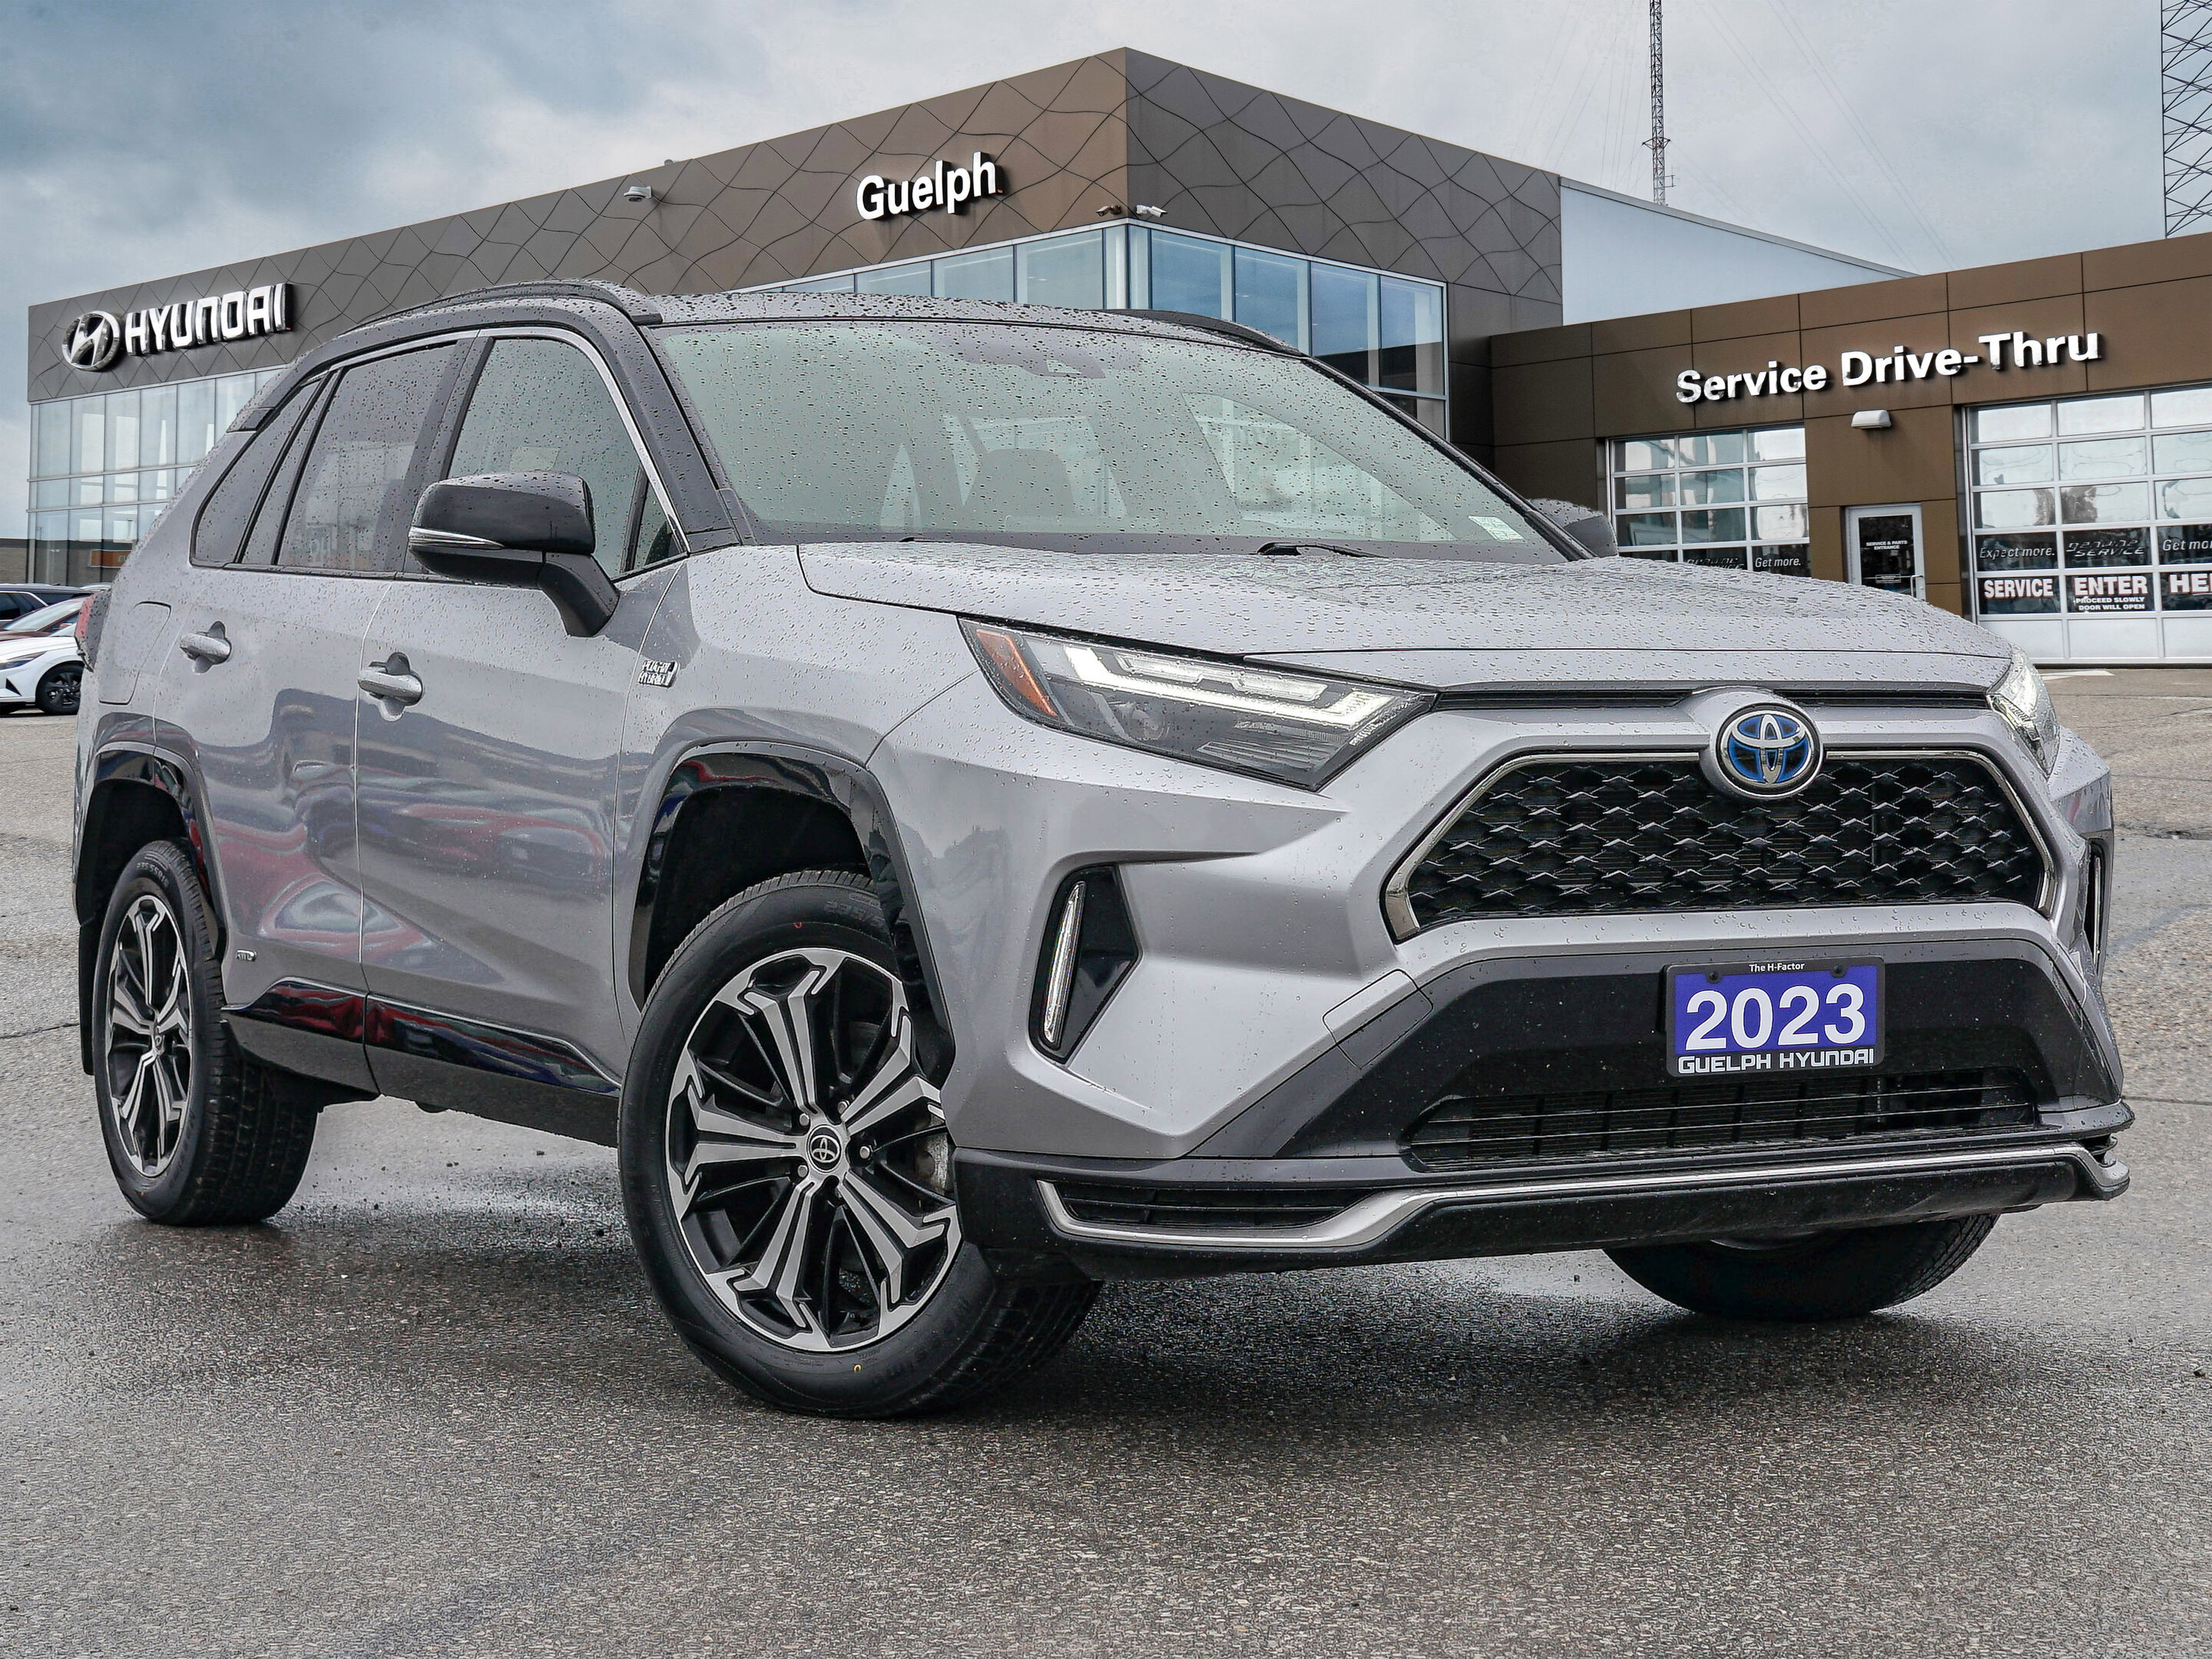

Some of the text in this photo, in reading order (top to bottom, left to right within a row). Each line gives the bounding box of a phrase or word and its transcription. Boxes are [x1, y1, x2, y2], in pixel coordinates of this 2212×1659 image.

[856, 151, 997, 220] Guelph
[124, 282, 289, 356] HYUNDAI
[1676, 330, 2102, 403] Service Drive-Thru
[1979, 545, 2055, 560] Expect more.
[2066, 539, 2139, 552] genuine
[2074, 546, 2147, 558] SERVICE
[2162, 539, 2187, 551] Get
[1755, 557, 1802, 568] Get more.
[1983, 578, 2054, 599] SERVICE
[2073, 575, 2149, 597] ENTER
[2169, 572, 2212, 594] HE
[1749, 962, 1805, 972] The H-Factor
[1685, 983, 1866, 1051] 2023
[1677, 1048, 1875, 1075] GUELPH HYUNDAI
